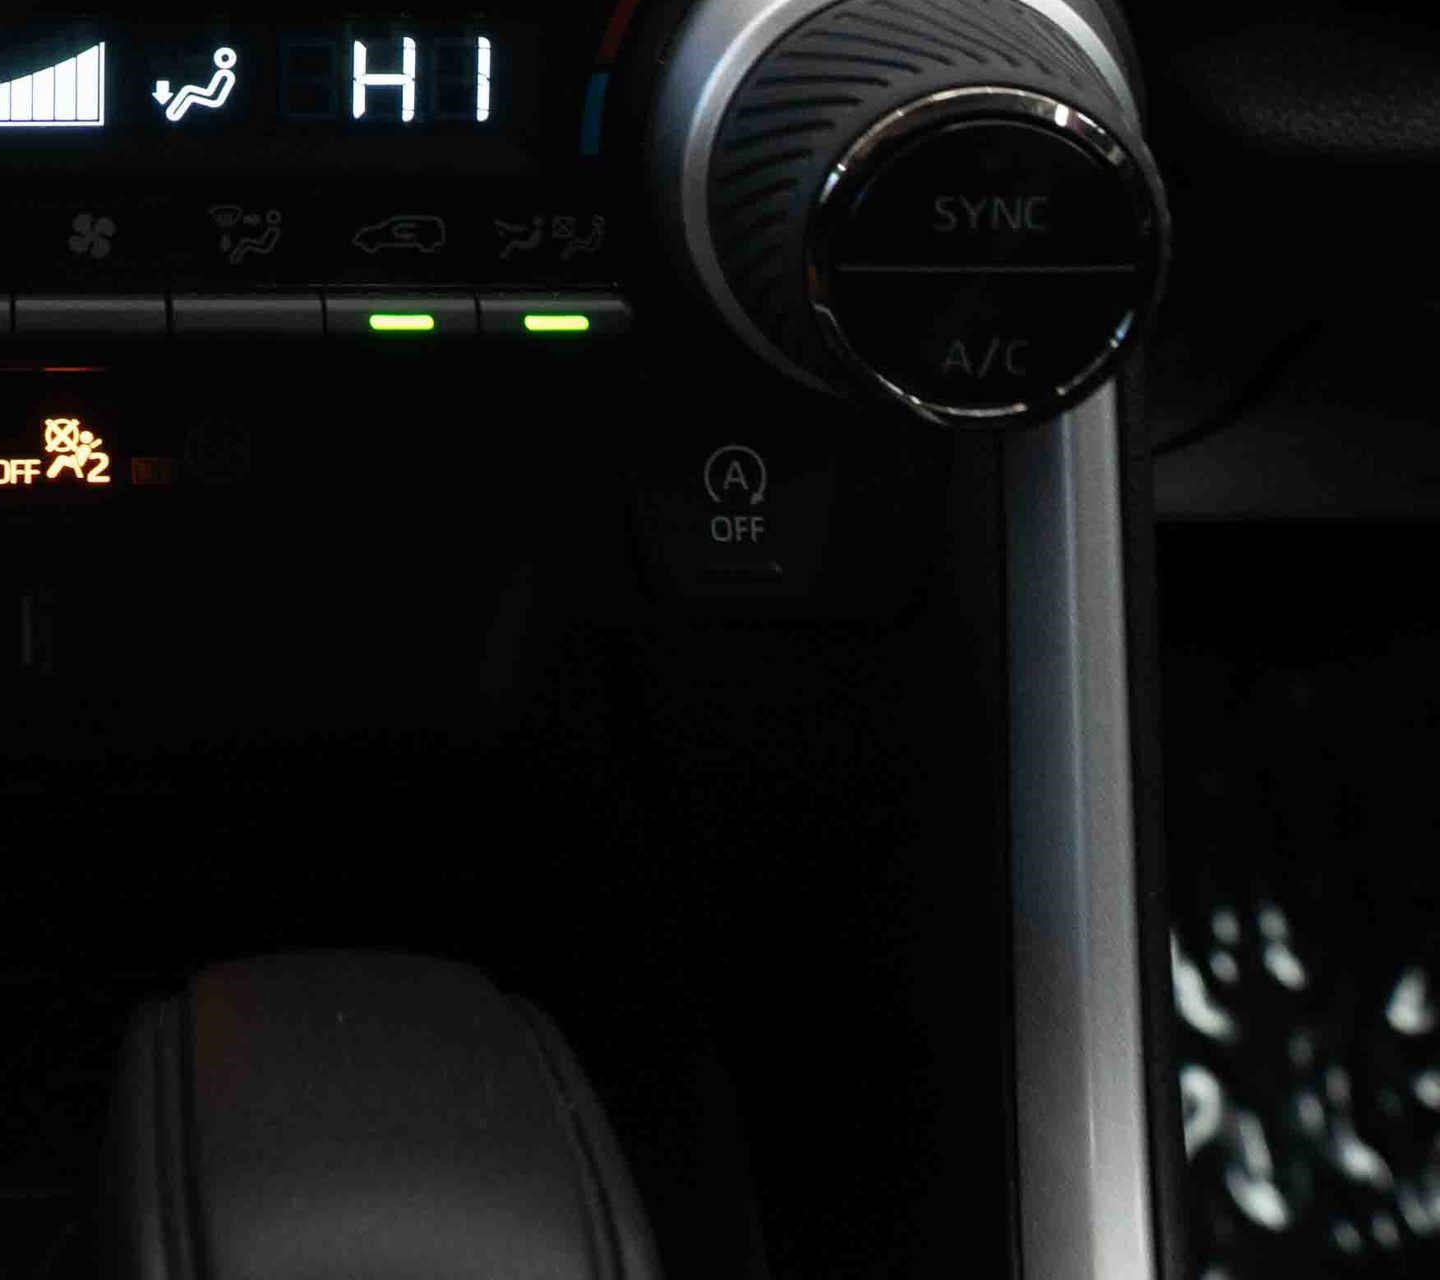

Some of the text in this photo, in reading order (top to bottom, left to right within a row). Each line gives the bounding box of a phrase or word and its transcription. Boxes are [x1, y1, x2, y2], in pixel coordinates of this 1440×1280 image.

[351, 36, 492, 123] HI
[932, 193, 1050, 236] SYNC
[940, 336, 1030, 380] A/C
[709, 516, 765, 544] OFF
